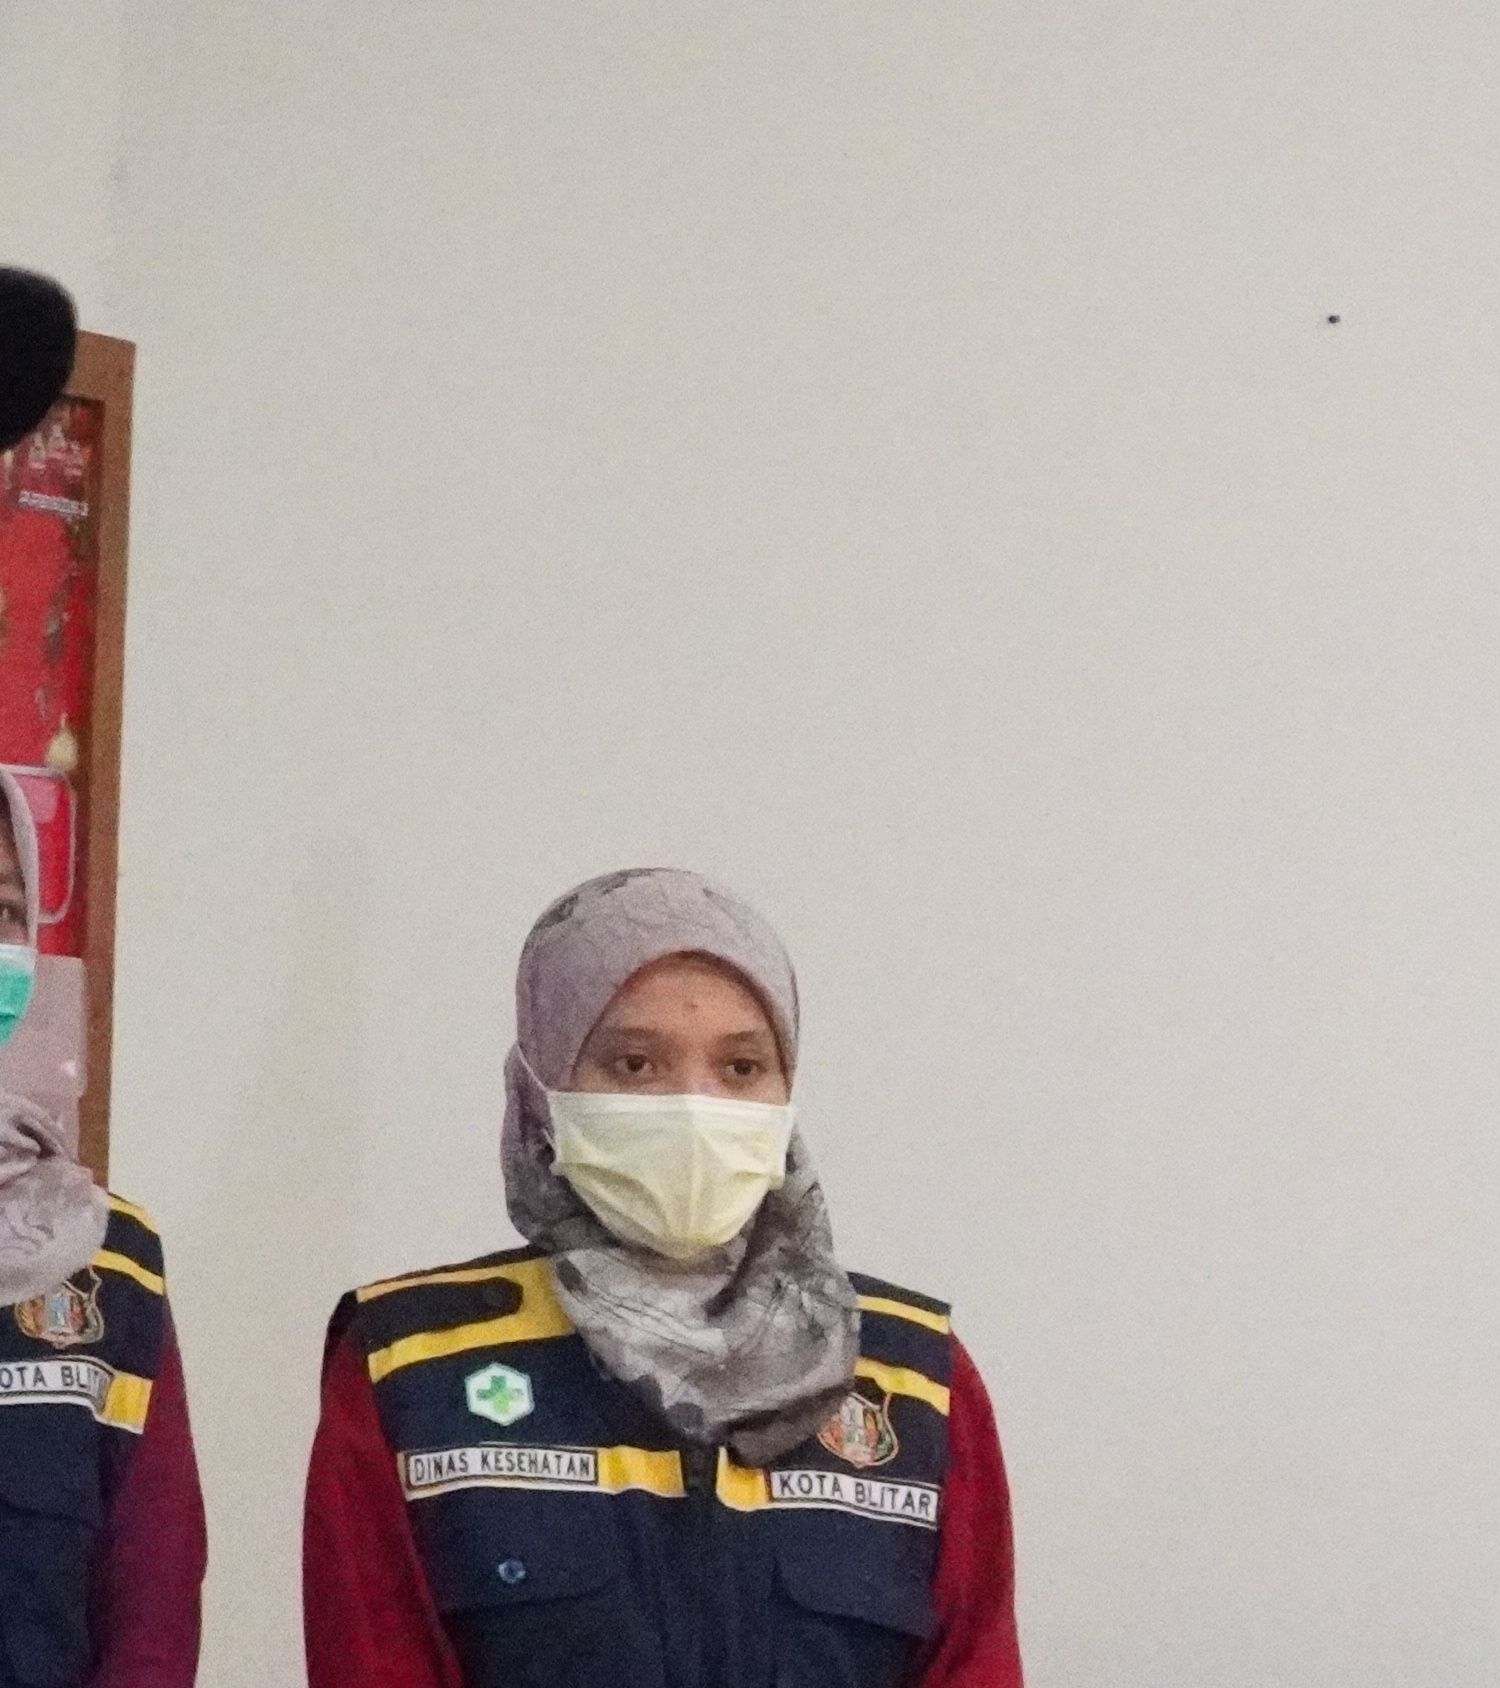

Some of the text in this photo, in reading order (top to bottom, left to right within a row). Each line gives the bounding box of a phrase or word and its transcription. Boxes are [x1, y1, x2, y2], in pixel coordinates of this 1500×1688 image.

[0, 1365, 47, 1389] OTA
[414, 1450, 591, 1482] DINAS KESEHATAN
[779, 1474, 932, 1517] KOTA BLITAR
